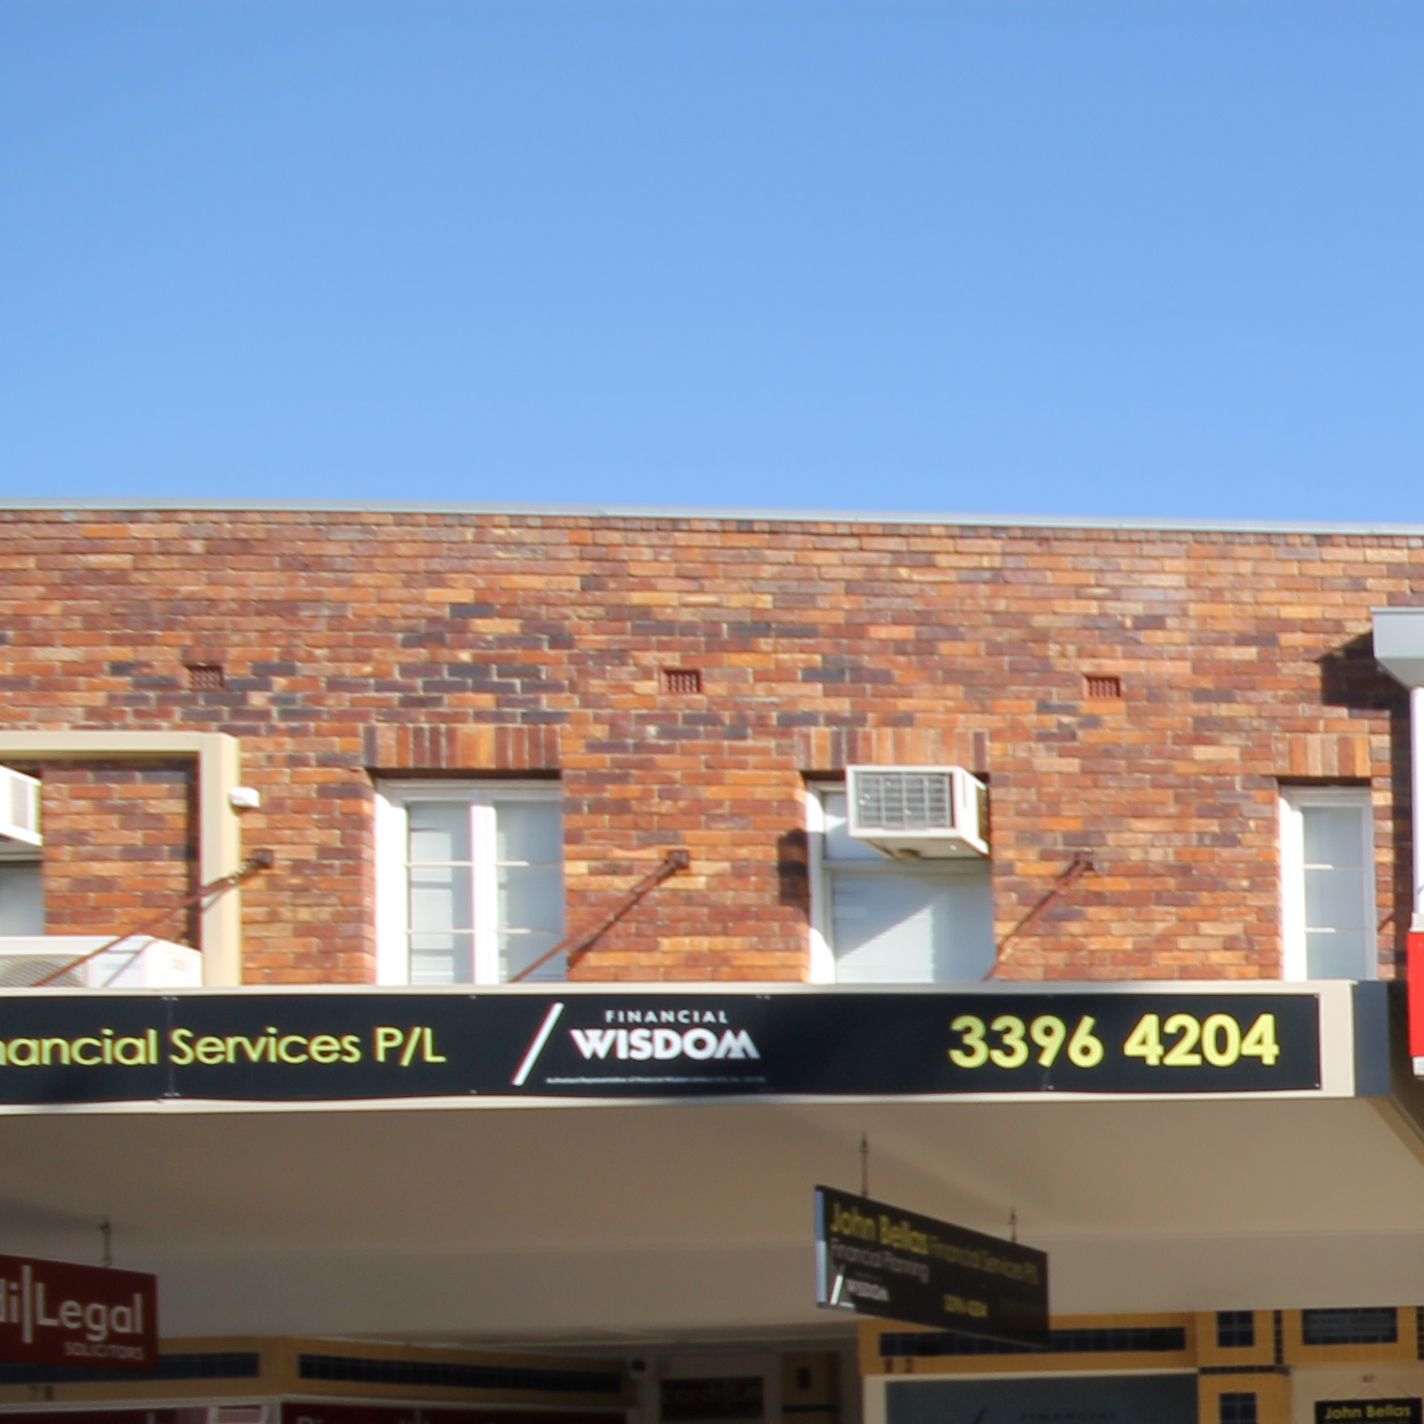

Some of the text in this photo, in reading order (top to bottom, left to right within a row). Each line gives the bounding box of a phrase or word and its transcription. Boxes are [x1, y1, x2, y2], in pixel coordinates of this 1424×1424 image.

[604, 1009, 729, 1024] FINANCIAL
[171, 1027, 360, 1066] Services
[375, 1026, 447, 1066] P/L
[568, 1027, 762, 1061] WISDOM
[948, 1012, 1280, 1068] 3396 4204
[35, 1282, 144, 1342] Legal
[1324, 1403, 1412, 1420] John Bellas
